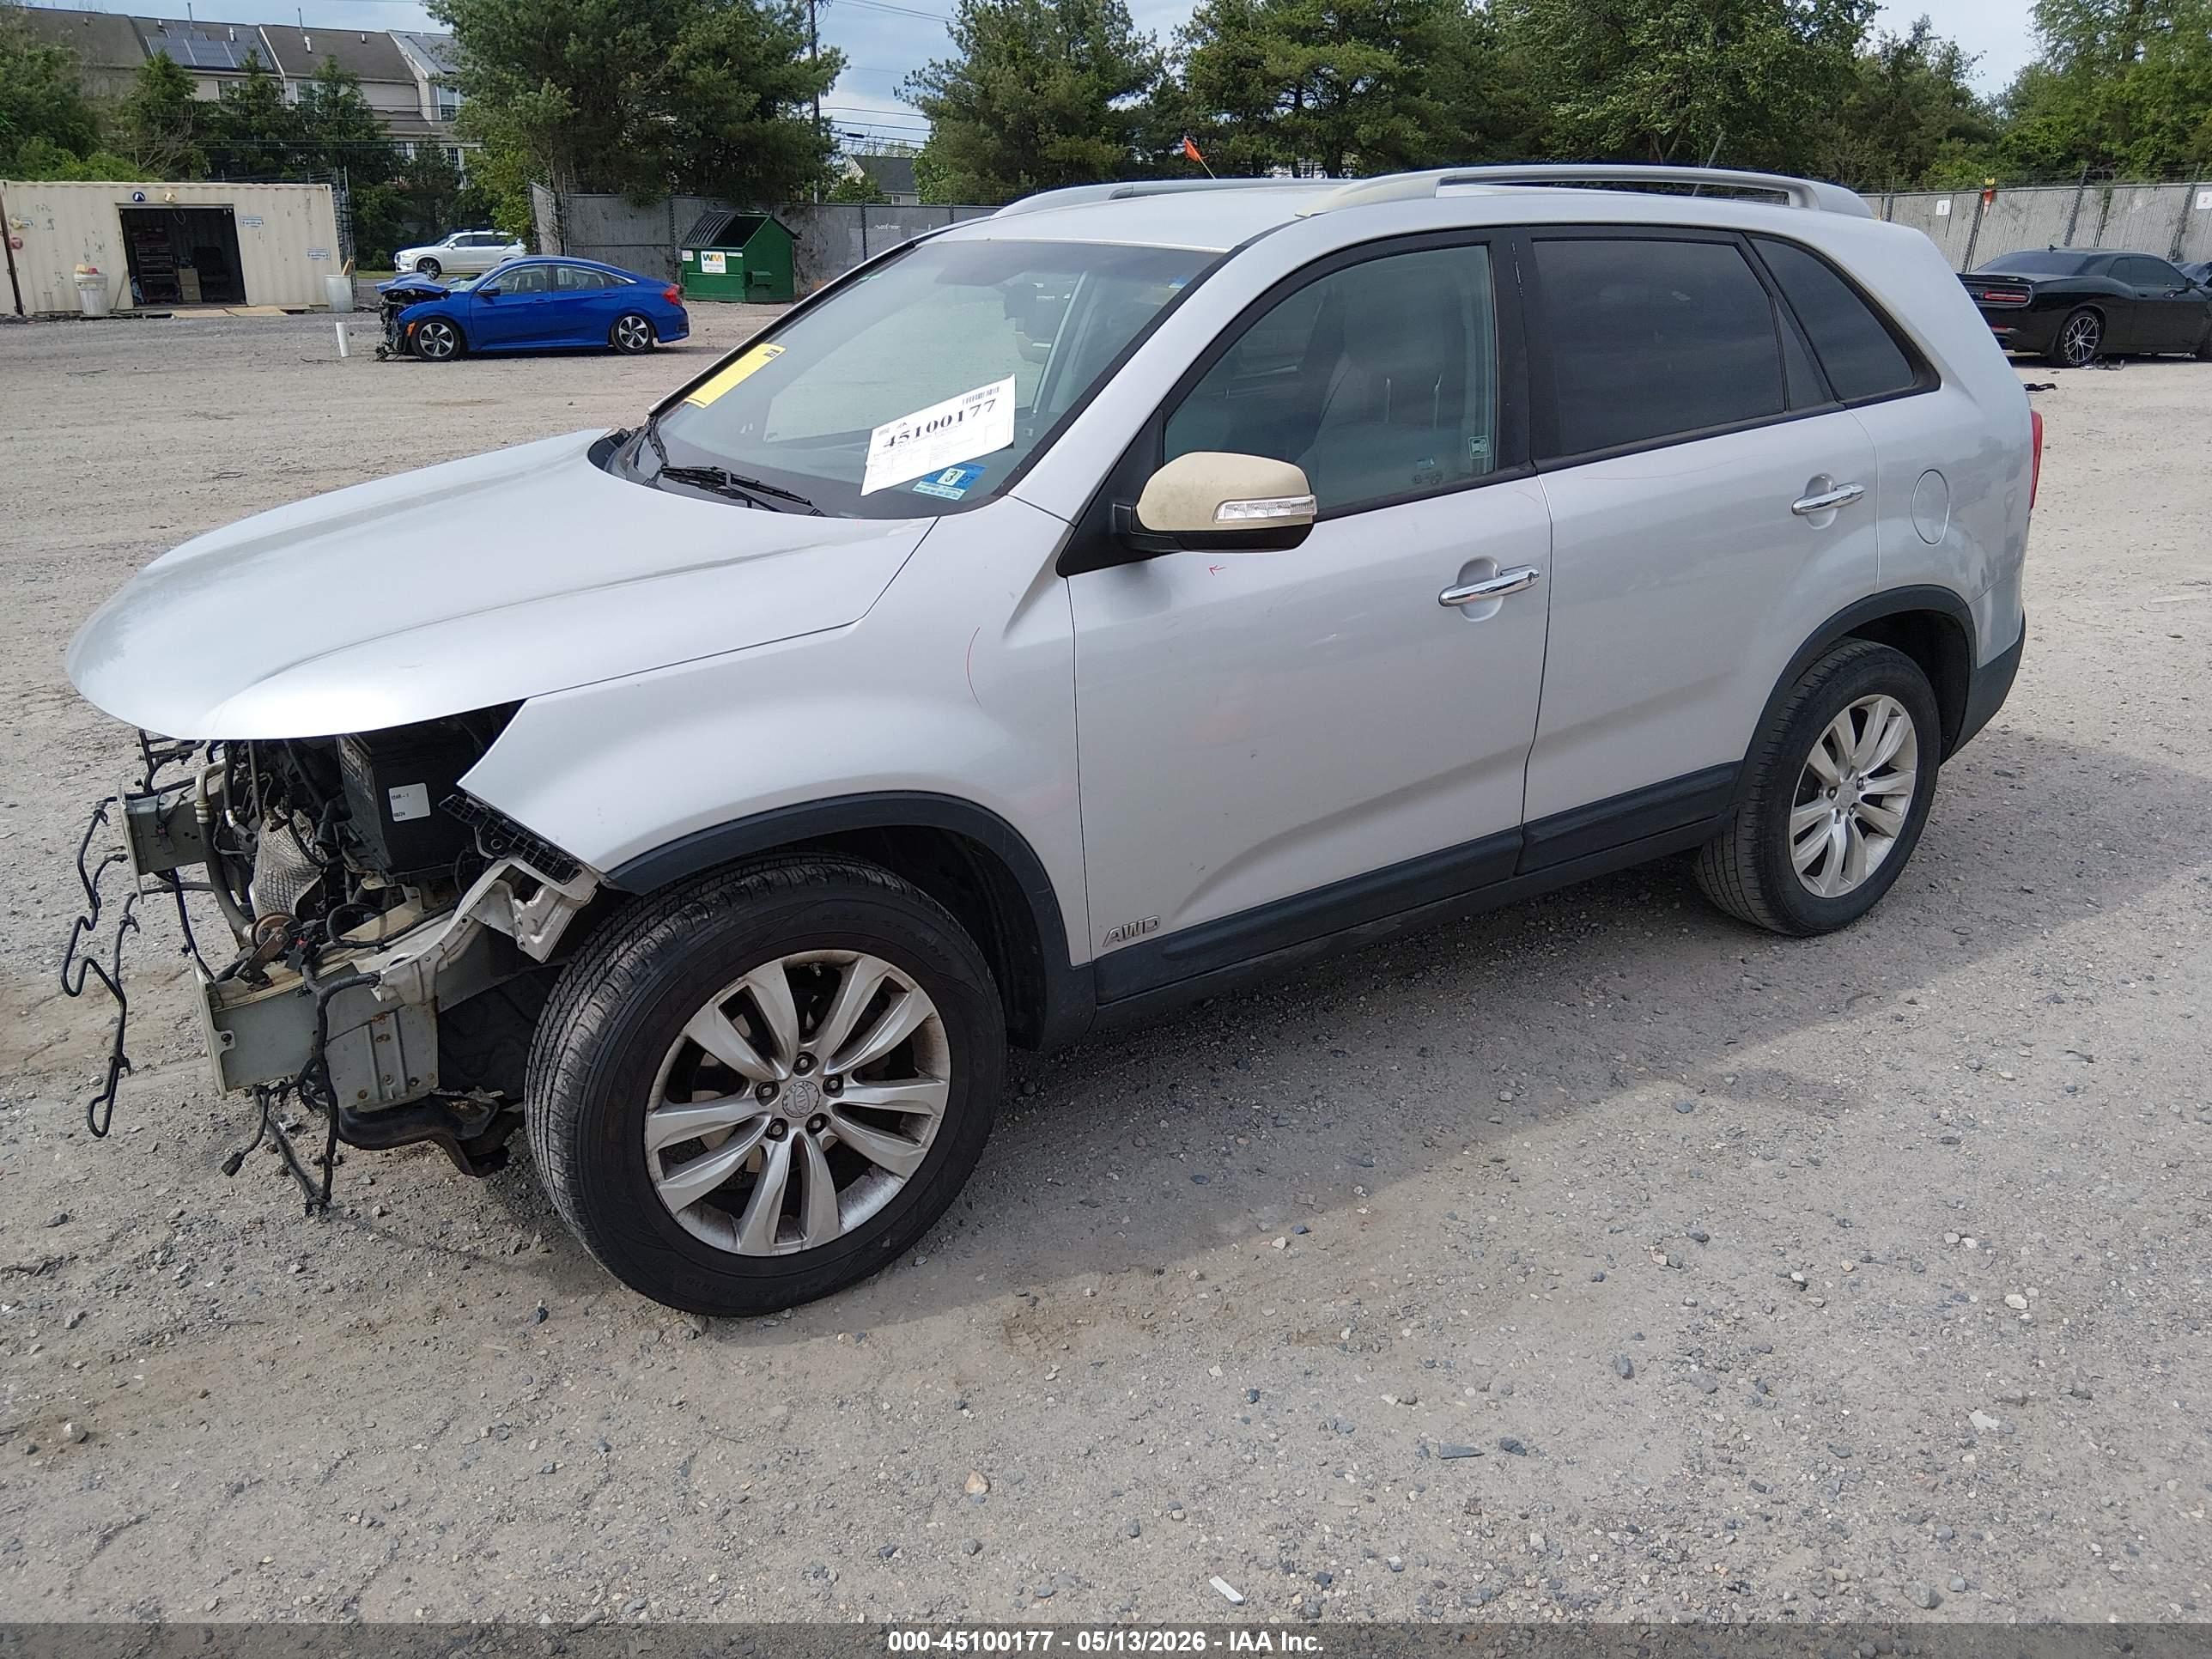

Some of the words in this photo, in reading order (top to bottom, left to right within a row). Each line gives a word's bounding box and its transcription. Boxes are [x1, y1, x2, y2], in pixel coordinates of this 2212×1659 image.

[702, 253, 723, 262] WM
[883, 398, 996, 447] 45100177
[945, 470, 958, 483] 3
[1102, 915, 1161, 948] AWD
